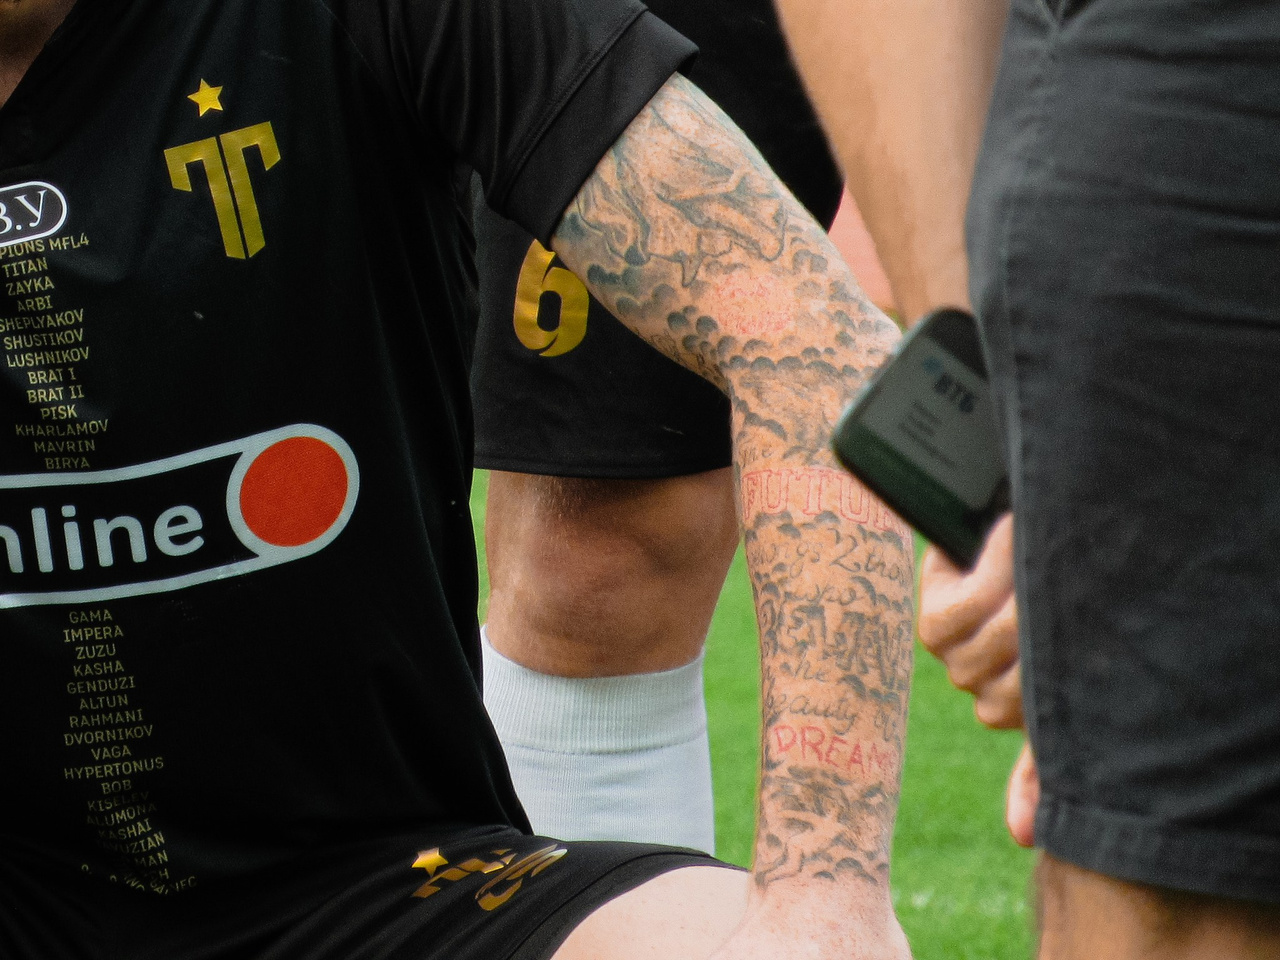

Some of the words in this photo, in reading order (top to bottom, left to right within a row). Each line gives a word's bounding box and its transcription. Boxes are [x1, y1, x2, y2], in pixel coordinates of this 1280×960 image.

[49, 233, 89, 251] MFL4
[2, 257, 48, 278] TITAN
[6, 276, 54, 296] ZAYKA
[17, 295, 53, 312] ARBI
[4, 328, 84, 350] SHUSTIKOV
[6, 346, 89, 368] LUSHNIKOV
[27, 368, 63, 385] BRAT
[68, 367, 76, 380] I
[27, 387, 63, 404] BRAT
[70, 385, 84, 399] II
[40, 404, 78, 420] PISK
[15, 419, 108, 437] KHARLAMOV
[34, 440, 96, 453] MAVRIN
[44, 457, 90, 470] BIRYA
[69, 609, 112, 624] GAMA
[63, 625, 124, 643] IMPERA
[75, 643, 116, 660] ZUZU
[73, 660, 124, 677] KASHA
[66, 676, 136, 694] GENDUZI
[79, 694, 128, 710] ALTUN
[69, 709, 143, 728] RAHMANI
[63, 724, 153, 746] DVORNIKOV
[91, 745, 132, 760] VAGA
[64, 757, 164, 779] HYPERTONUS
[101, 779, 132, 794] BOB
